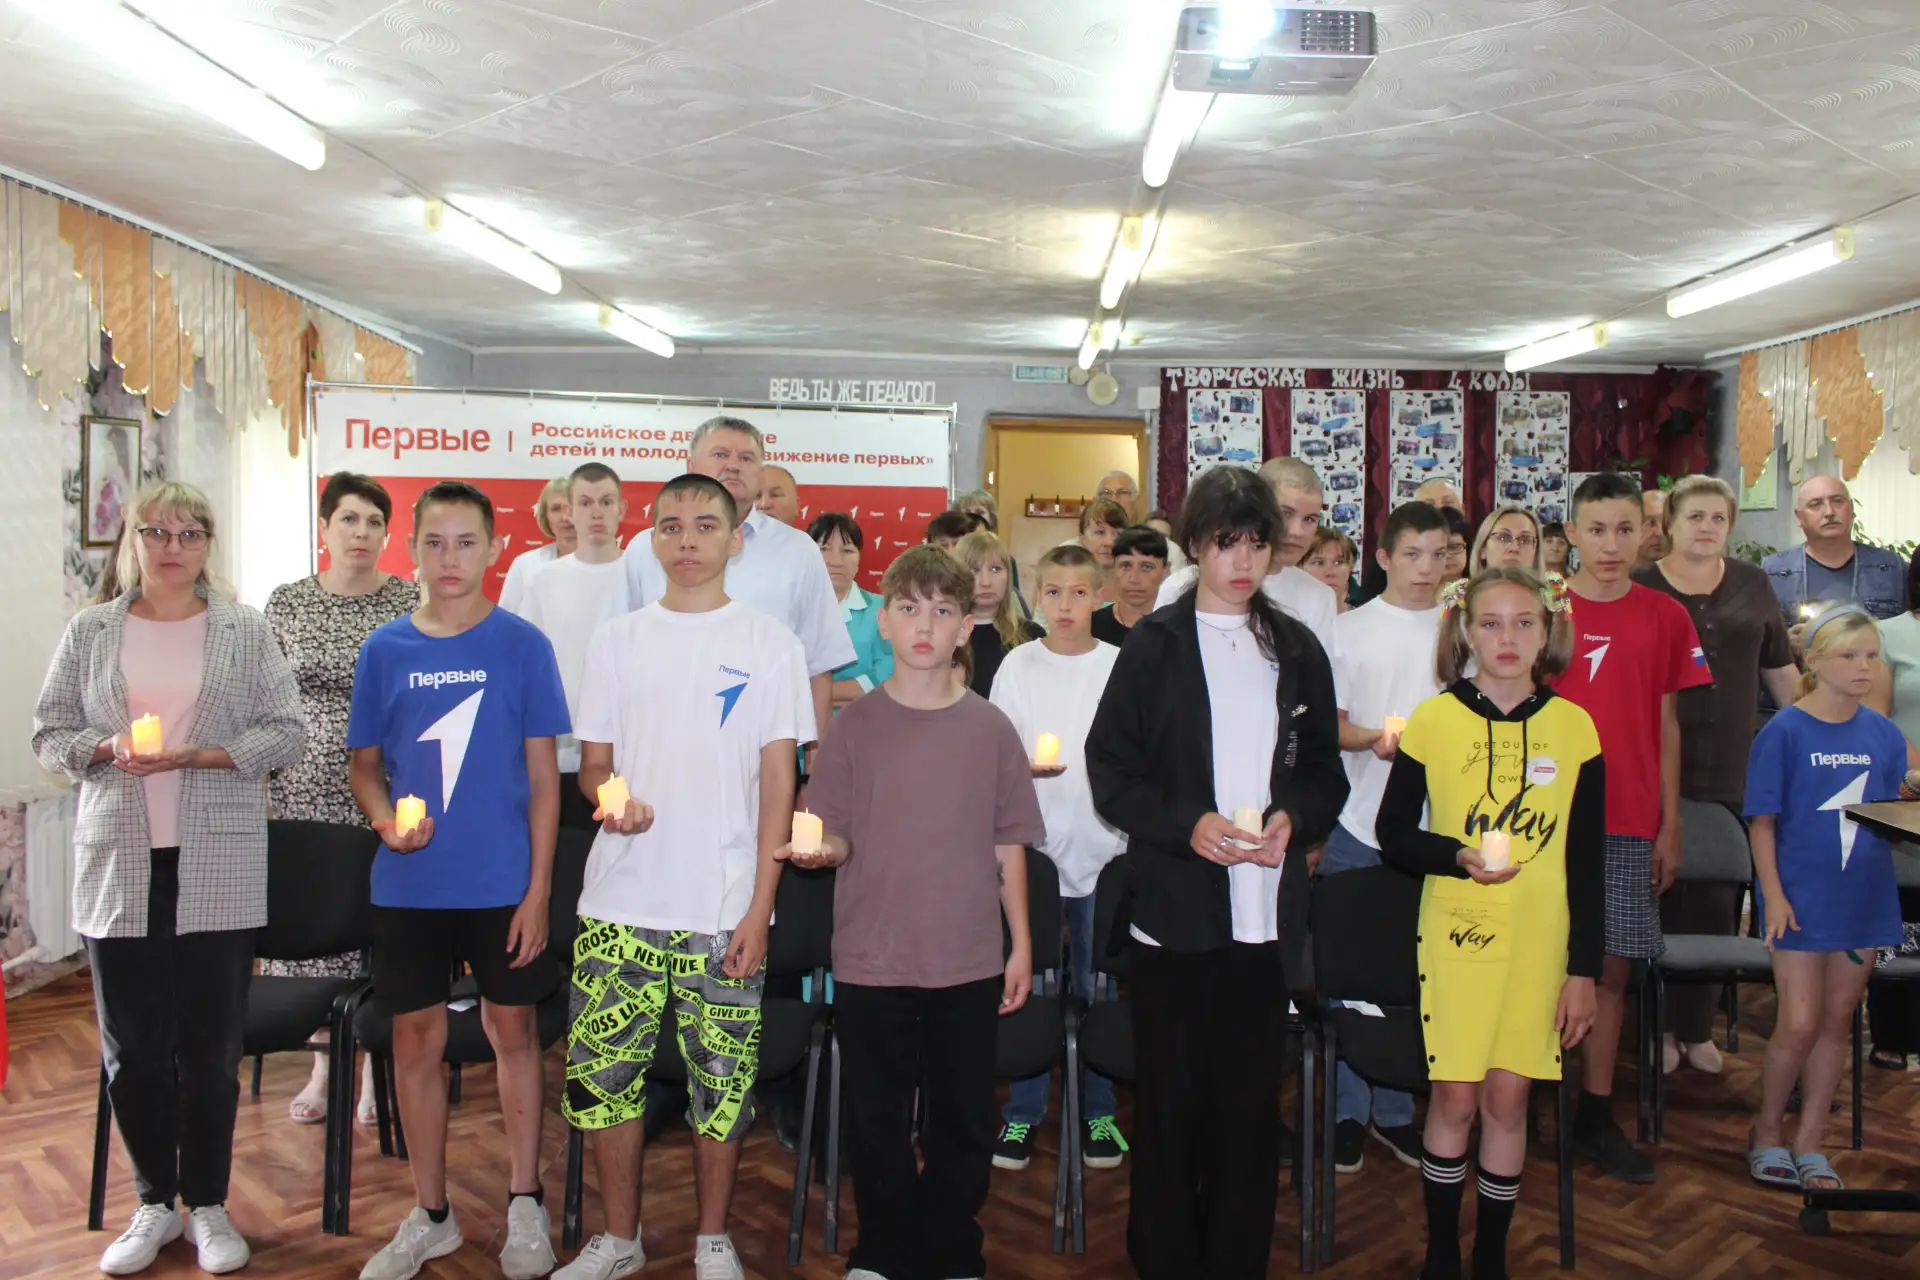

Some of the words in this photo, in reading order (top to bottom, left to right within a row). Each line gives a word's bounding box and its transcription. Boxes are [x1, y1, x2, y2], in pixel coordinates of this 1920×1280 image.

[1331, 368, 1404, 390] ЖИЗНЬ
[770, 378, 809, 401] ВЕДЬ
[812, 379, 833, 402] ТЫ
[837, 380, 861, 402] ЖЕ
[345, 418, 491, 460] Первые
[531, 422, 667, 441] Российское
[530, 442, 596, 457] детей
[602, 446, 615, 457] и
[620, 447, 689, 461] молод
[764, 450, 850, 464] вижение
[1583, 633, 1611, 642] Первые
[409, 669, 487, 690] Первые
[718, 664, 751, 679] Первые
[1502, 741, 1521, 749] OU
[1533, 742, 1549, 751] OF
[1810, 752, 1871, 769] Первые
[578, 923, 620, 956] CROSS
[672, 957, 699, 974] IVE
[709, 1007, 735, 1018] GIVE
[736, 1009, 751, 1019] UP
[584, 1013, 619, 1036] ROSS
[601, 1045, 620, 1058] LINE
[707, 1040, 727, 1053] TREC
[603, 1112, 624, 1125] TREC
